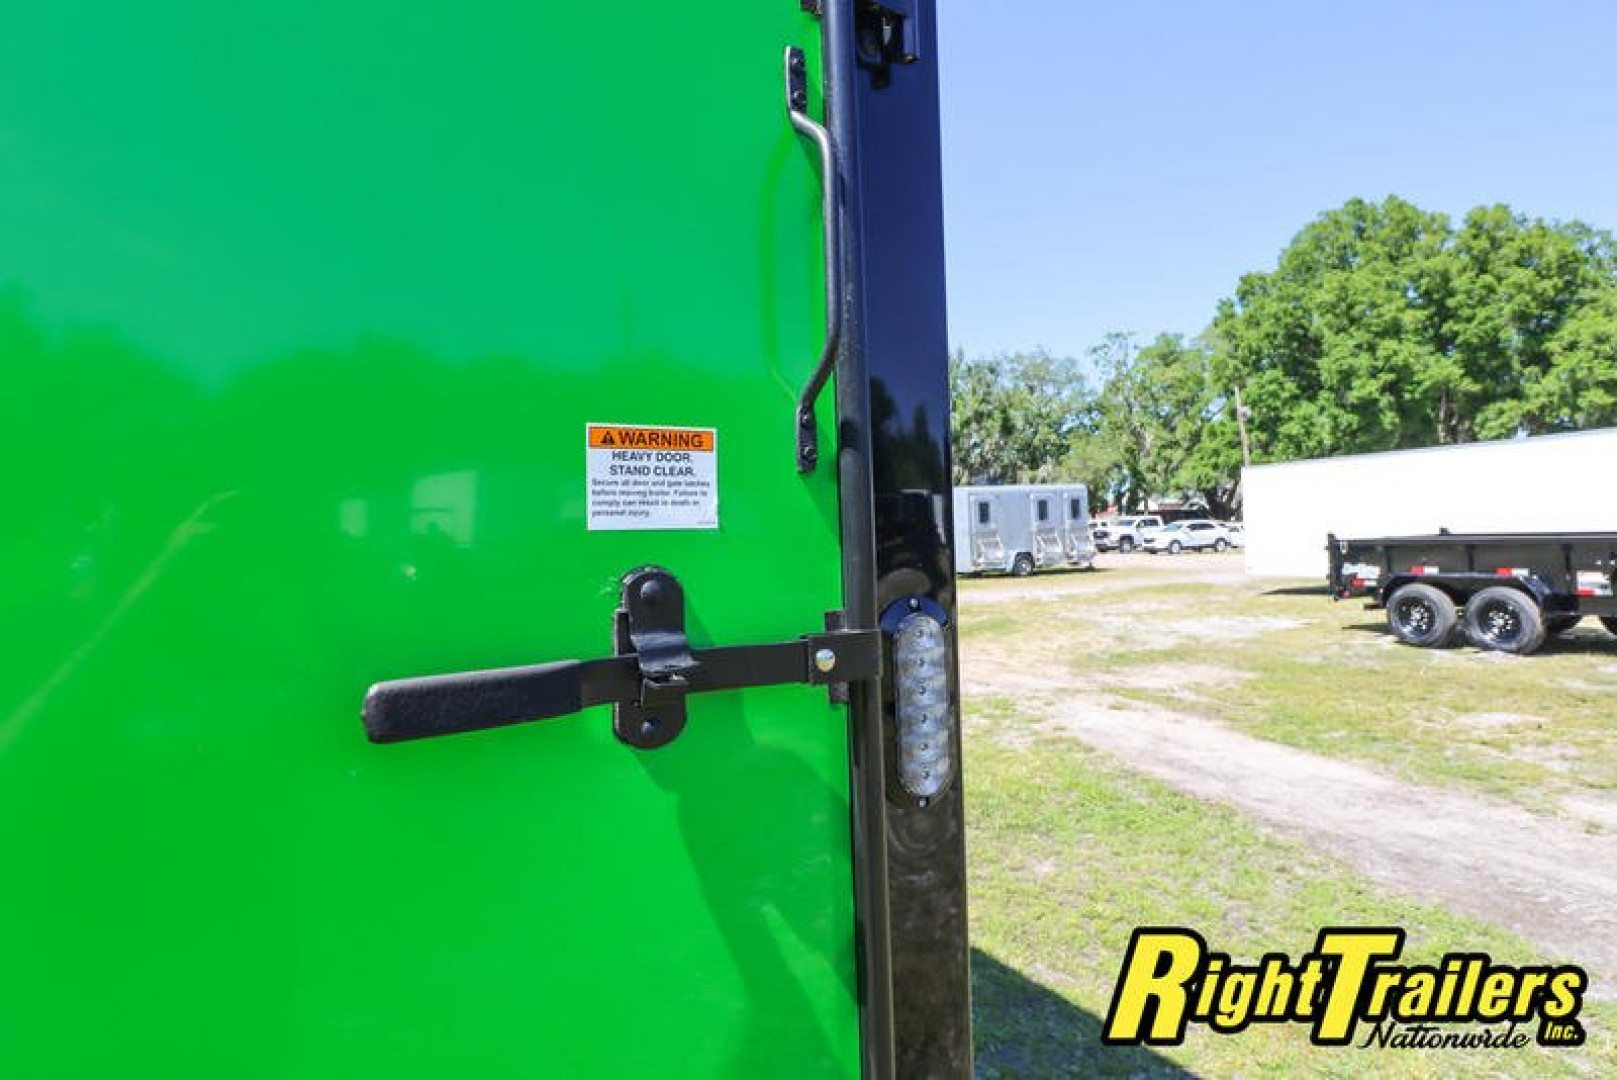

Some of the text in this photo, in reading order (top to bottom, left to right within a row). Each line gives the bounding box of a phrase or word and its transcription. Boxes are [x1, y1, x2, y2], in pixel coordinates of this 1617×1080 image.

[618, 432, 703, 447] WARNING
[612, 451, 652, 462] HEAVY
[610, 465, 695, 476] STAND CLEAR.
